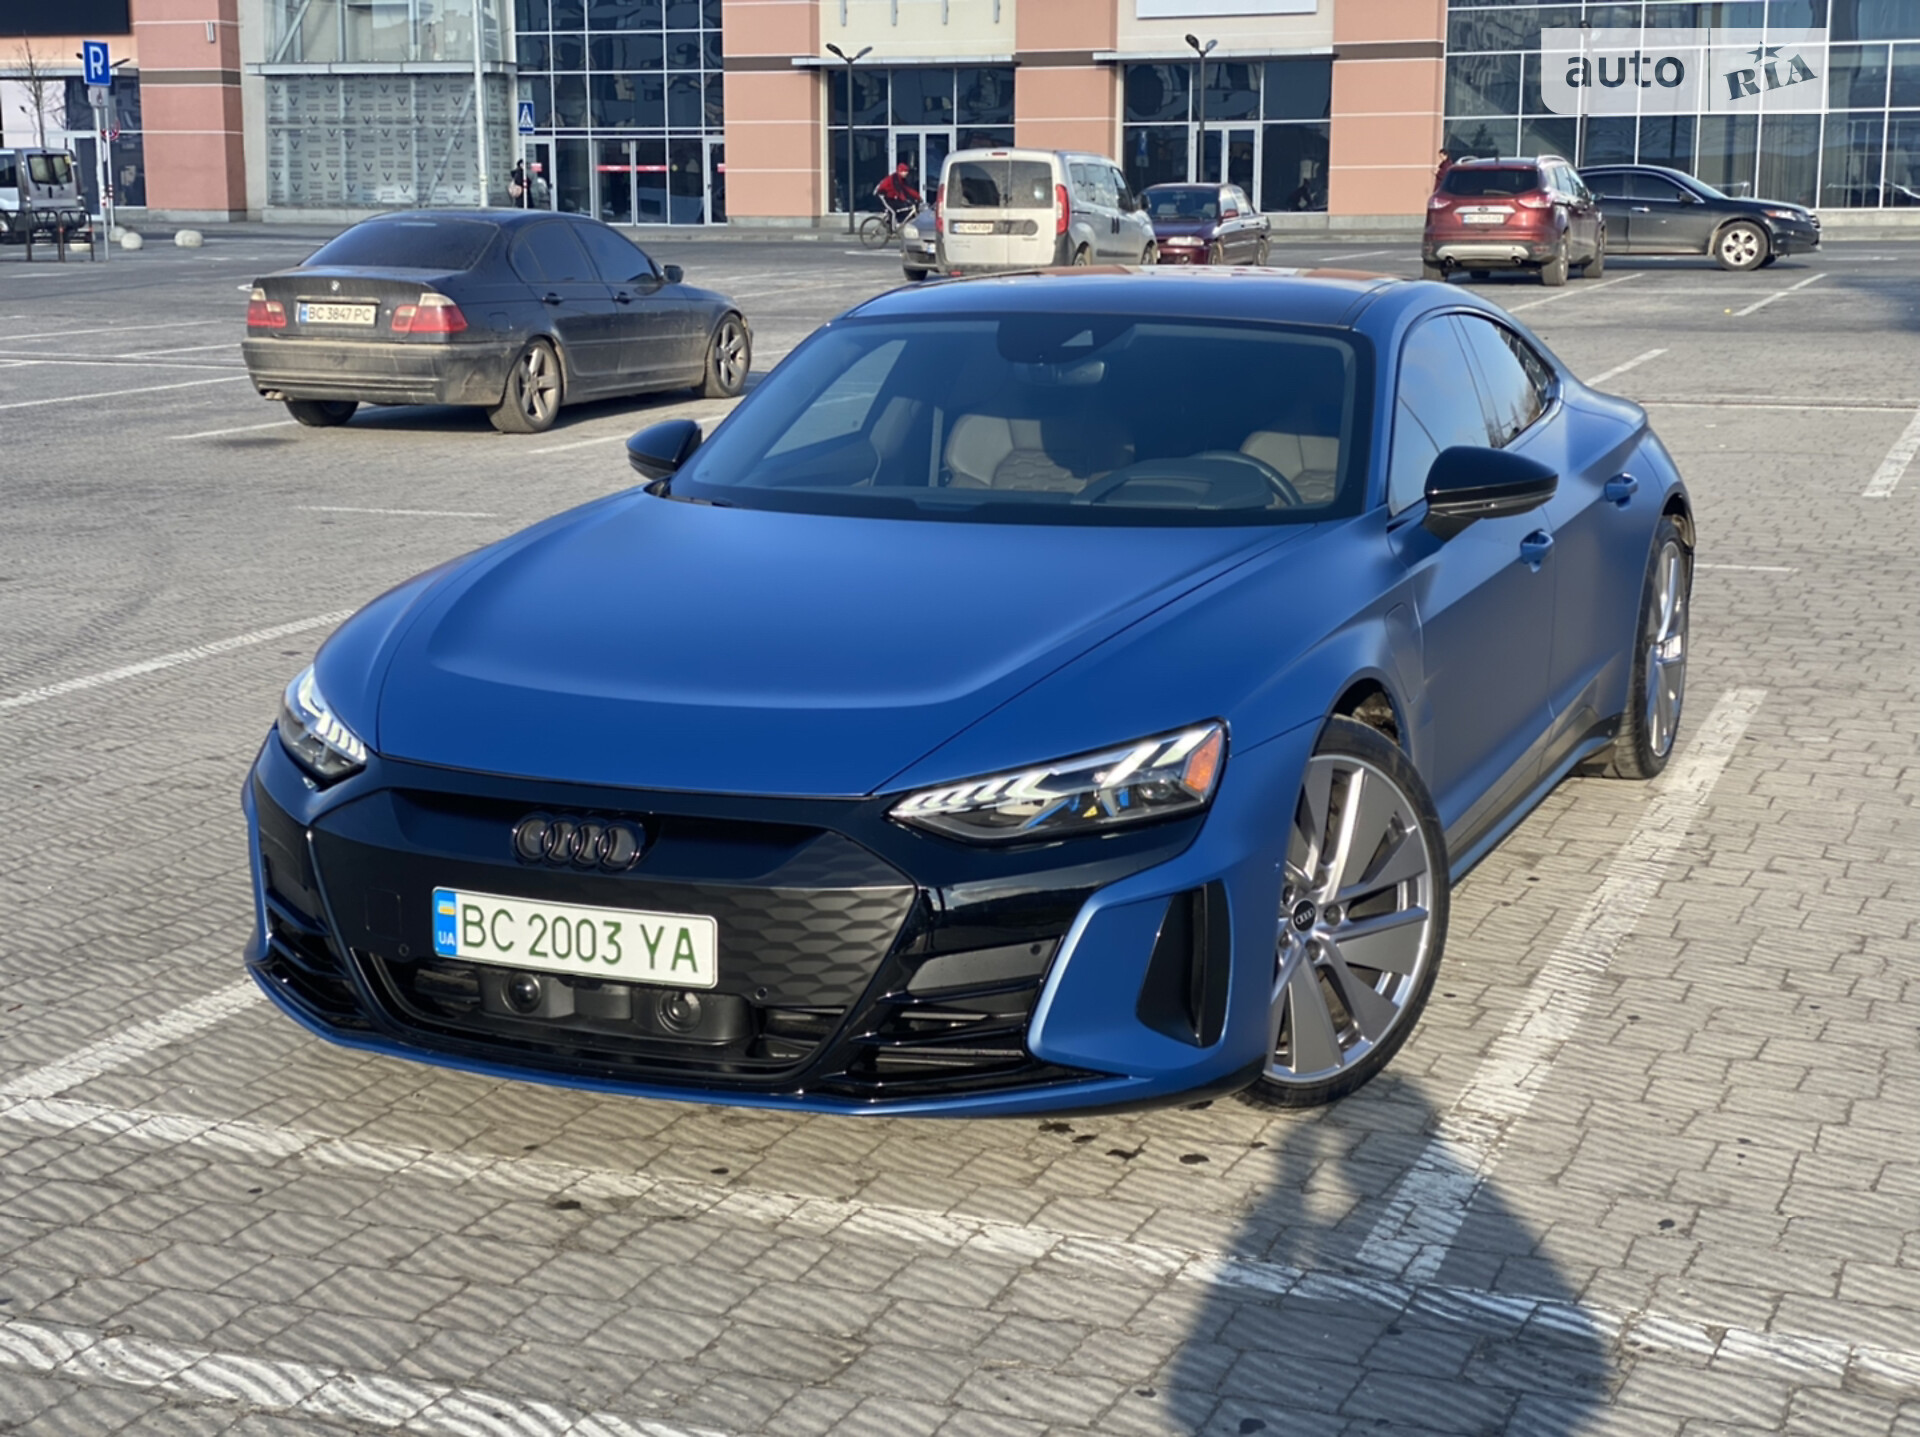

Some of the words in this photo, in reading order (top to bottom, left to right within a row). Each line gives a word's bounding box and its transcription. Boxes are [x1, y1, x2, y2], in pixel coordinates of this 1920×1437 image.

[308, 307, 324, 320] BC
[327, 307, 353, 321] 3847
[354, 308, 371, 321] PC
[438, 931, 456, 946] UA
[461, 903, 515, 952] BC
[527, 913, 622, 966] 2003
[639, 924, 698, 974] YA
